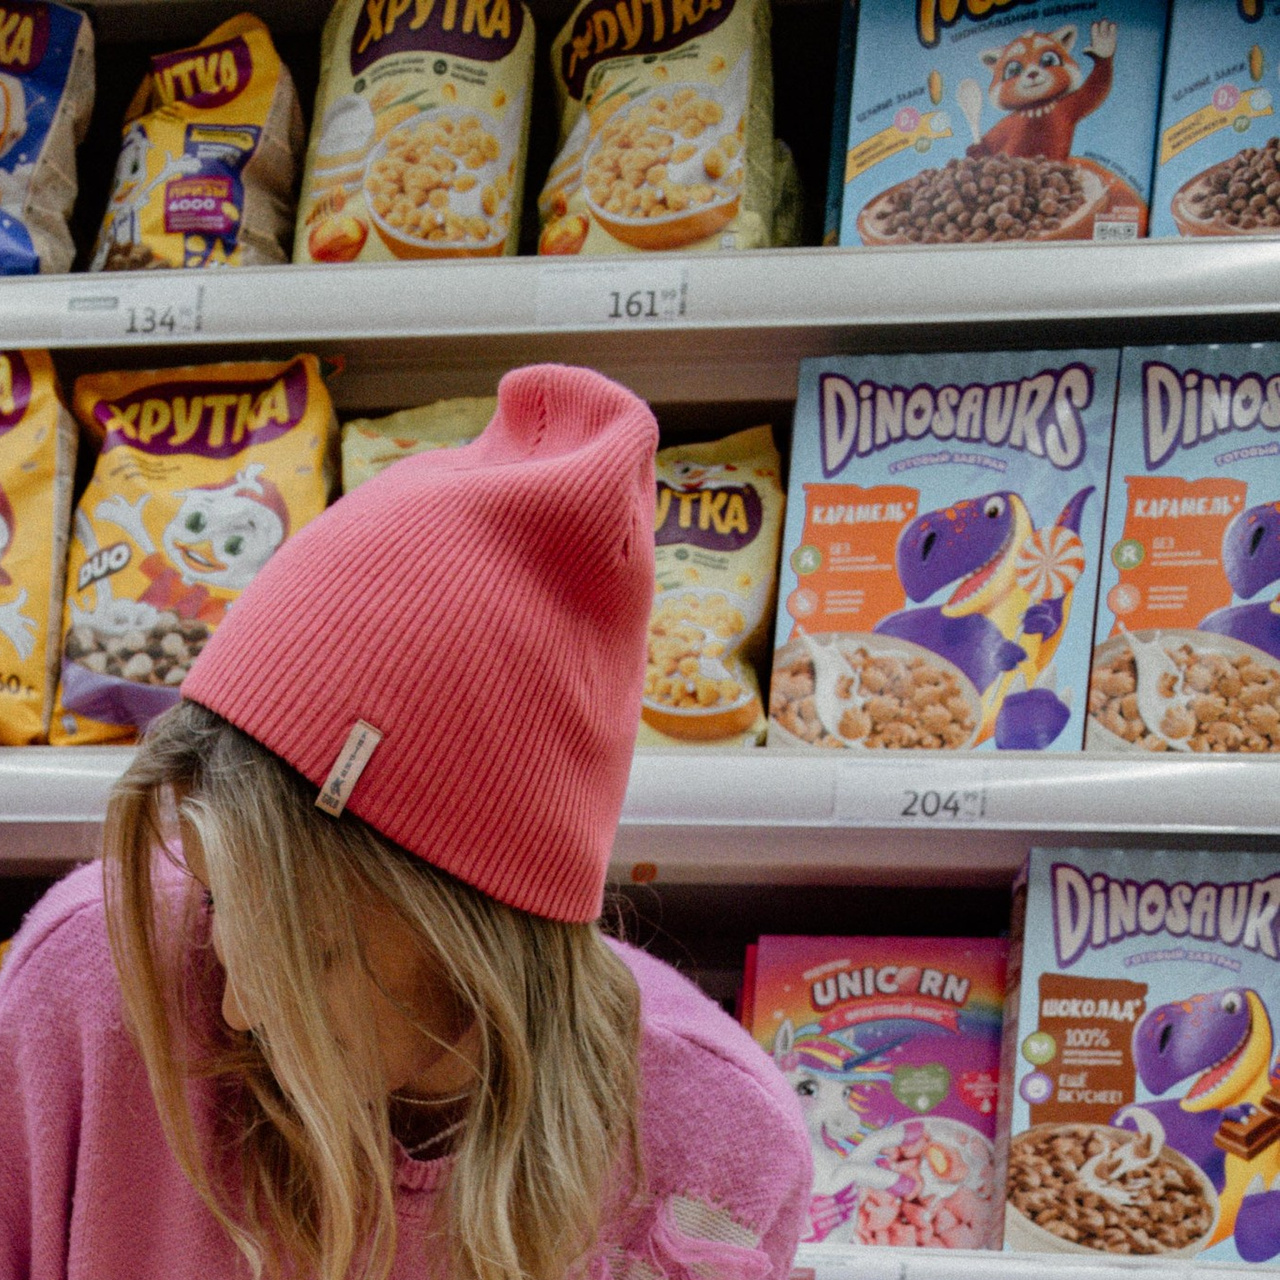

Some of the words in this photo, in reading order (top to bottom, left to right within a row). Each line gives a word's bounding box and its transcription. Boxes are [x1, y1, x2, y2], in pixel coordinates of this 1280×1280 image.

[153, 50, 240, 96] УТКА
[124, 306, 177, 334] 134
[608, 291, 659, 319] 161
[108, 381, 291, 447] ХРУТКА
[1144, 361, 1280, 470] DiNOS
[656, 491, 750, 536] УТКА
[78, 544, 130, 590] DUO
[900, 790, 960, 818] 204
[1051, 863, 1280, 968] DiNOSAUR
[1041, 998, 1136, 1023] ШОКОЛАД
[1064, 1028, 1111, 1048] 100%
